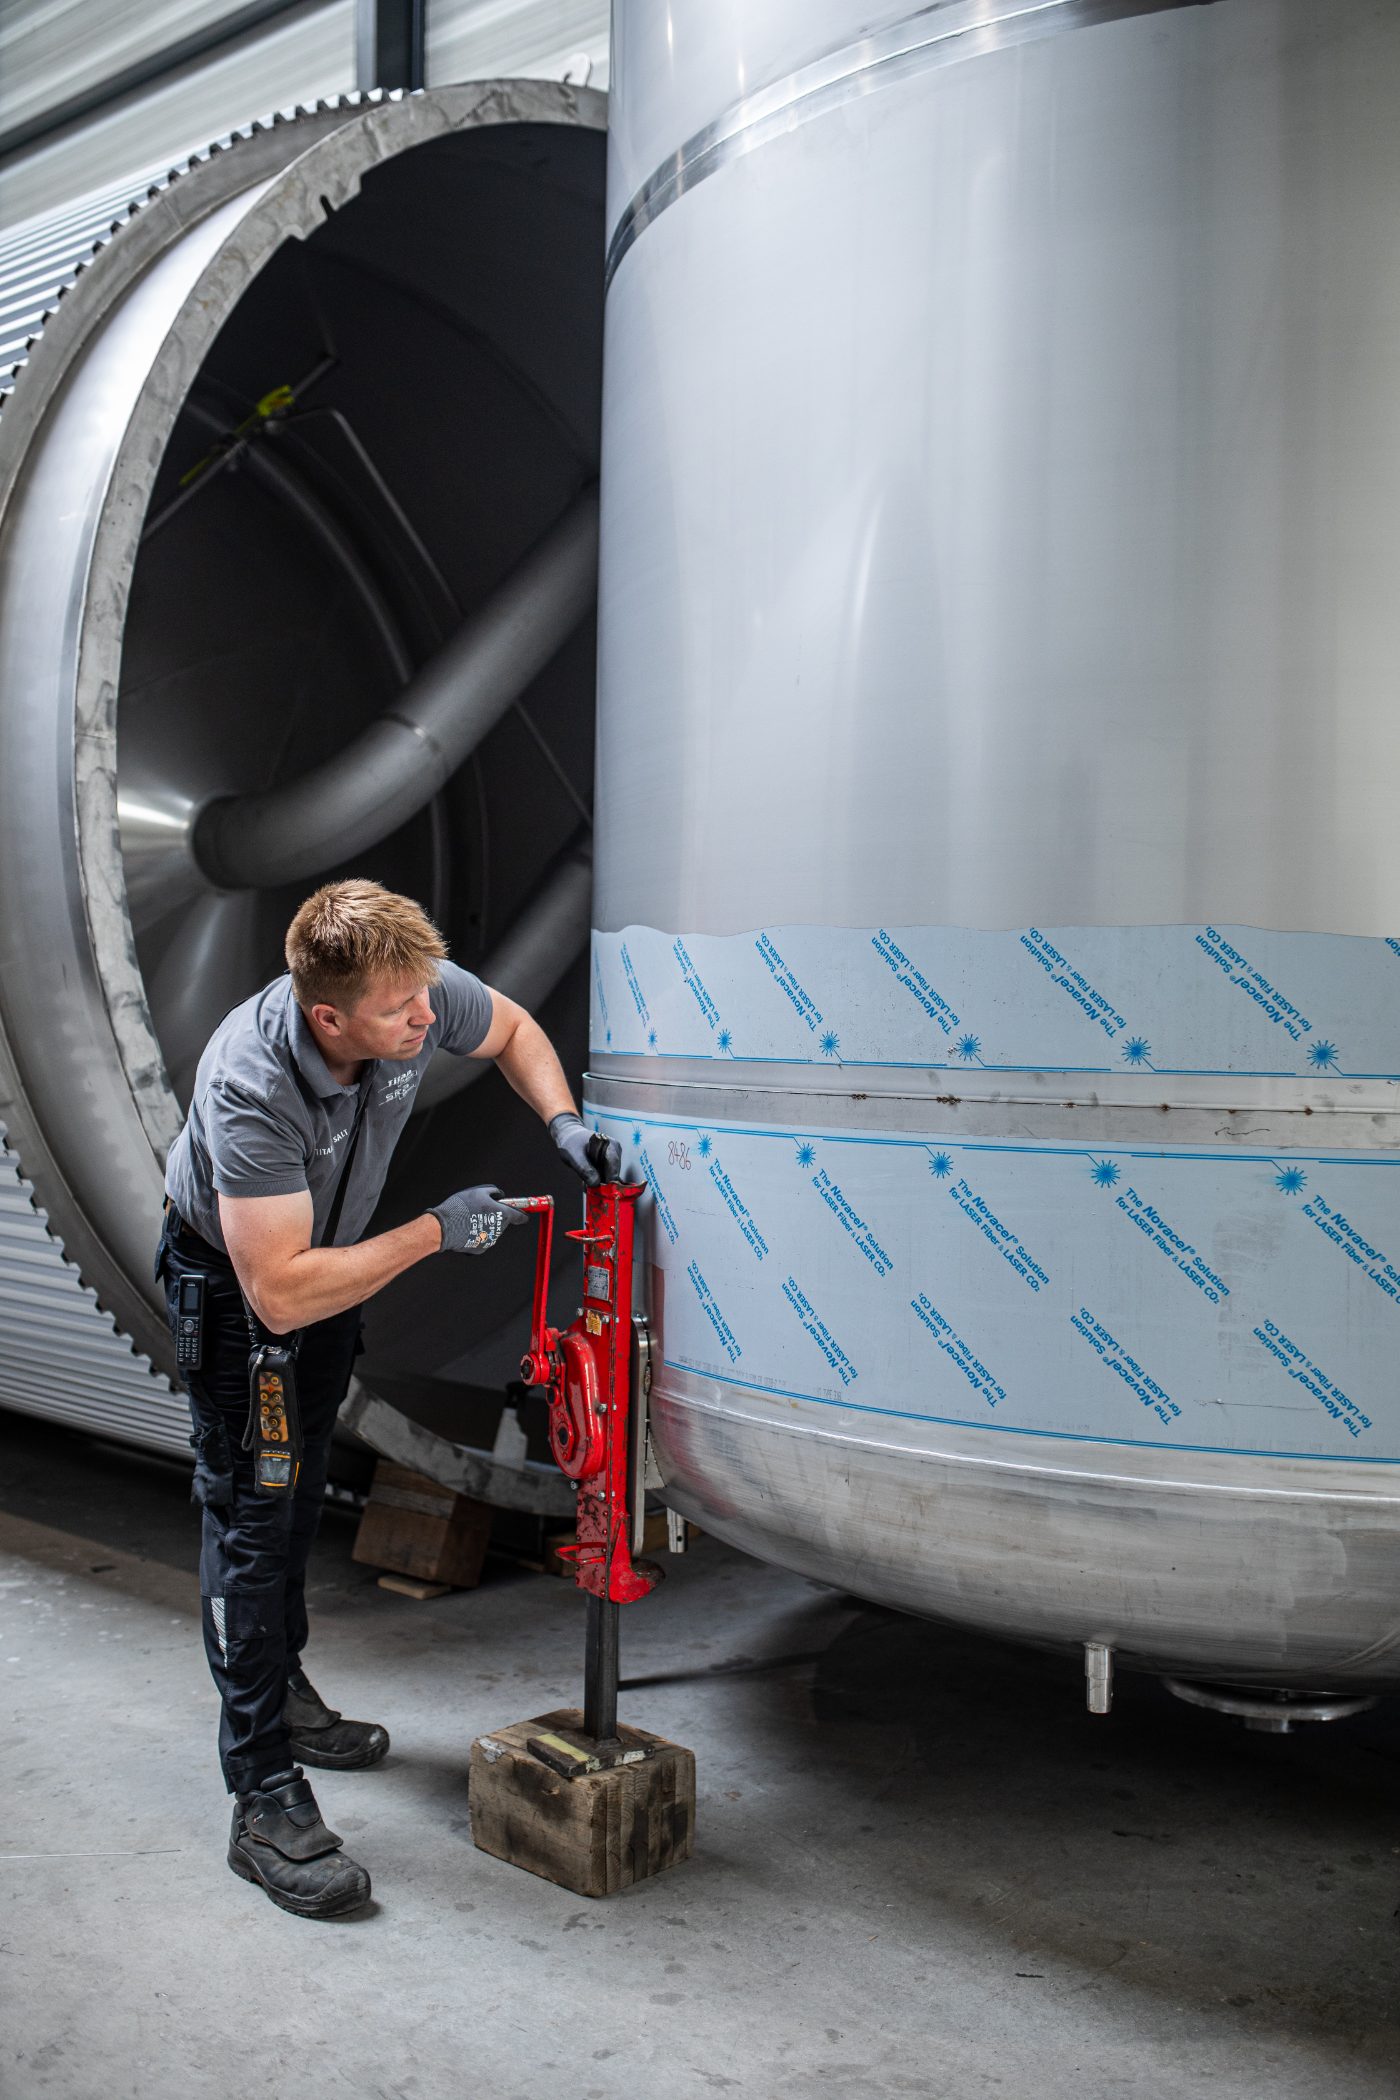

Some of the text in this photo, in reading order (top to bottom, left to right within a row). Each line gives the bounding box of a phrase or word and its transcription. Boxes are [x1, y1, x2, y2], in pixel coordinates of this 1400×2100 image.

[754, 940, 776, 974] Solution
[768, 945, 785, 968] LASER
[870, 937, 899, 972] Solution
[889, 942, 911, 968] LASER
[1019, 935, 1054, 973] Solution
[1042, 941, 1068, 966] LASER
[1194, 935, 1233, 974] Solution
[1219, 941, 1248, 968] LASER
[786, 971, 799, 992] Fiber
[913, 970, 929, 992] Fiber
[1070, 971, 1090, 993] Fiber
[1251, 972, 1274, 995] Fiber
[797, 988, 816, 1013] LASER
[928, 991, 951, 1014] LASER
[1088, 992, 1116, 1017] LASER
[1272, 992, 1300, 1020] LASER
[804, 1014, 816, 1031] The
[813, 1010, 823, 1024] for
[938, 1016, 951, 1034] The
[948, 1012, 960, 1026] for
[1098, 1018, 1116, 1038] The
[1114, 1015, 1126, 1029] for
[1298, 1017, 1312, 1032] for
[1284, 1021, 1300, 1040] The
[333, 1129, 348, 1142] SALT
[668, 1140, 692, 1170] 8486
[708, 1164, 716, 1178] for
[714, 1176, 729, 1201] LASER
[727, 1198, 738, 1217] Fiber
[740, 1222, 756, 1246] LASER
[713, 1159, 724, 1177] The
[748, 1220, 768, 1255] Solution
[1313, 1195, 1332, 1216] The
[812, 1176, 823, 1190] for
[820, 1186, 839, 1213] LASER
[837, 1211, 852, 1232] Fiber
[856, 1236, 876, 1262] LASER
[819, 1168, 832, 1188] The
[865, 1232, 894, 1270] Solution
[950, 1186, 961, 1200] for
[960, 1198, 983, 1224] LASER
[982, 1223, 1000, 1246] Fiber
[1002, 1249, 1028, 1277] LASER
[957, 1179, 972, 1198] The
[1016, 1246, 1050, 1284] Solution
[1115, 1195, 1131, 1212] for
[1126, 1208, 1155, 1236] LASER
[1152, 1234, 1175, 1257] Fiber
[1178, 1260, 1206, 1288] LASER
[1125, 1187, 1144, 1208] The
[1191, 1257, 1230, 1296] Solution
[1302, 1204, 1316, 1217] for
[1314, 1218, 1344, 1244] LASER
[1340, 1242, 1364, 1264] Fiber
[1368, 1269, 1397, 1296] LASER
[688, 1266, 705, 1301] Solution
[697, 1273, 711, 1296] LASER
[712, 1302, 723, 1323] Fiber
[781, 1283, 804, 1320] Solution
[796, 1291, 814, 1316] LASER
[816, 1320, 832, 1342] Fiber
[911, 1300, 941, 1339] Solution
[929, 1308, 953, 1334] LASER
[720, 1320, 736, 1344] LASER
[1071, 1316, 1106, 1354] Solution
[1092, 1324, 1120, 1352] LASER
[726, 1344, 736, 1364] The
[734, 1342, 742, 1356] for
[829, 1340, 850, 1366] LASER
[956, 1339, 974, 1361] Fiber
[1253, 1328, 1292, 1367] Solution
[1278, 1336, 1307, 1363] LASER
[838, 1366, 852, 1387] The
[848, 1366, 858, 1380] for
[972, 1360, 997, 1387] LASER
[1123, 1356, 1144, 1378] Fiber
[1310, 1368, 1333, 1390] Fiber
[982, 1387, 998, 1408] The
[994, 1384, 1006, 1400] for
[1143, 1377, 1170, 1404] LASER
[1330, 1388, 1360, 1416] LASER
[1154, 1406, 1172, 1424] The
[1167, 1403, 1181, 1416] for
[1357, 1414, 1372, 1429] for
[1342, 1417, 1360, 1437] The
